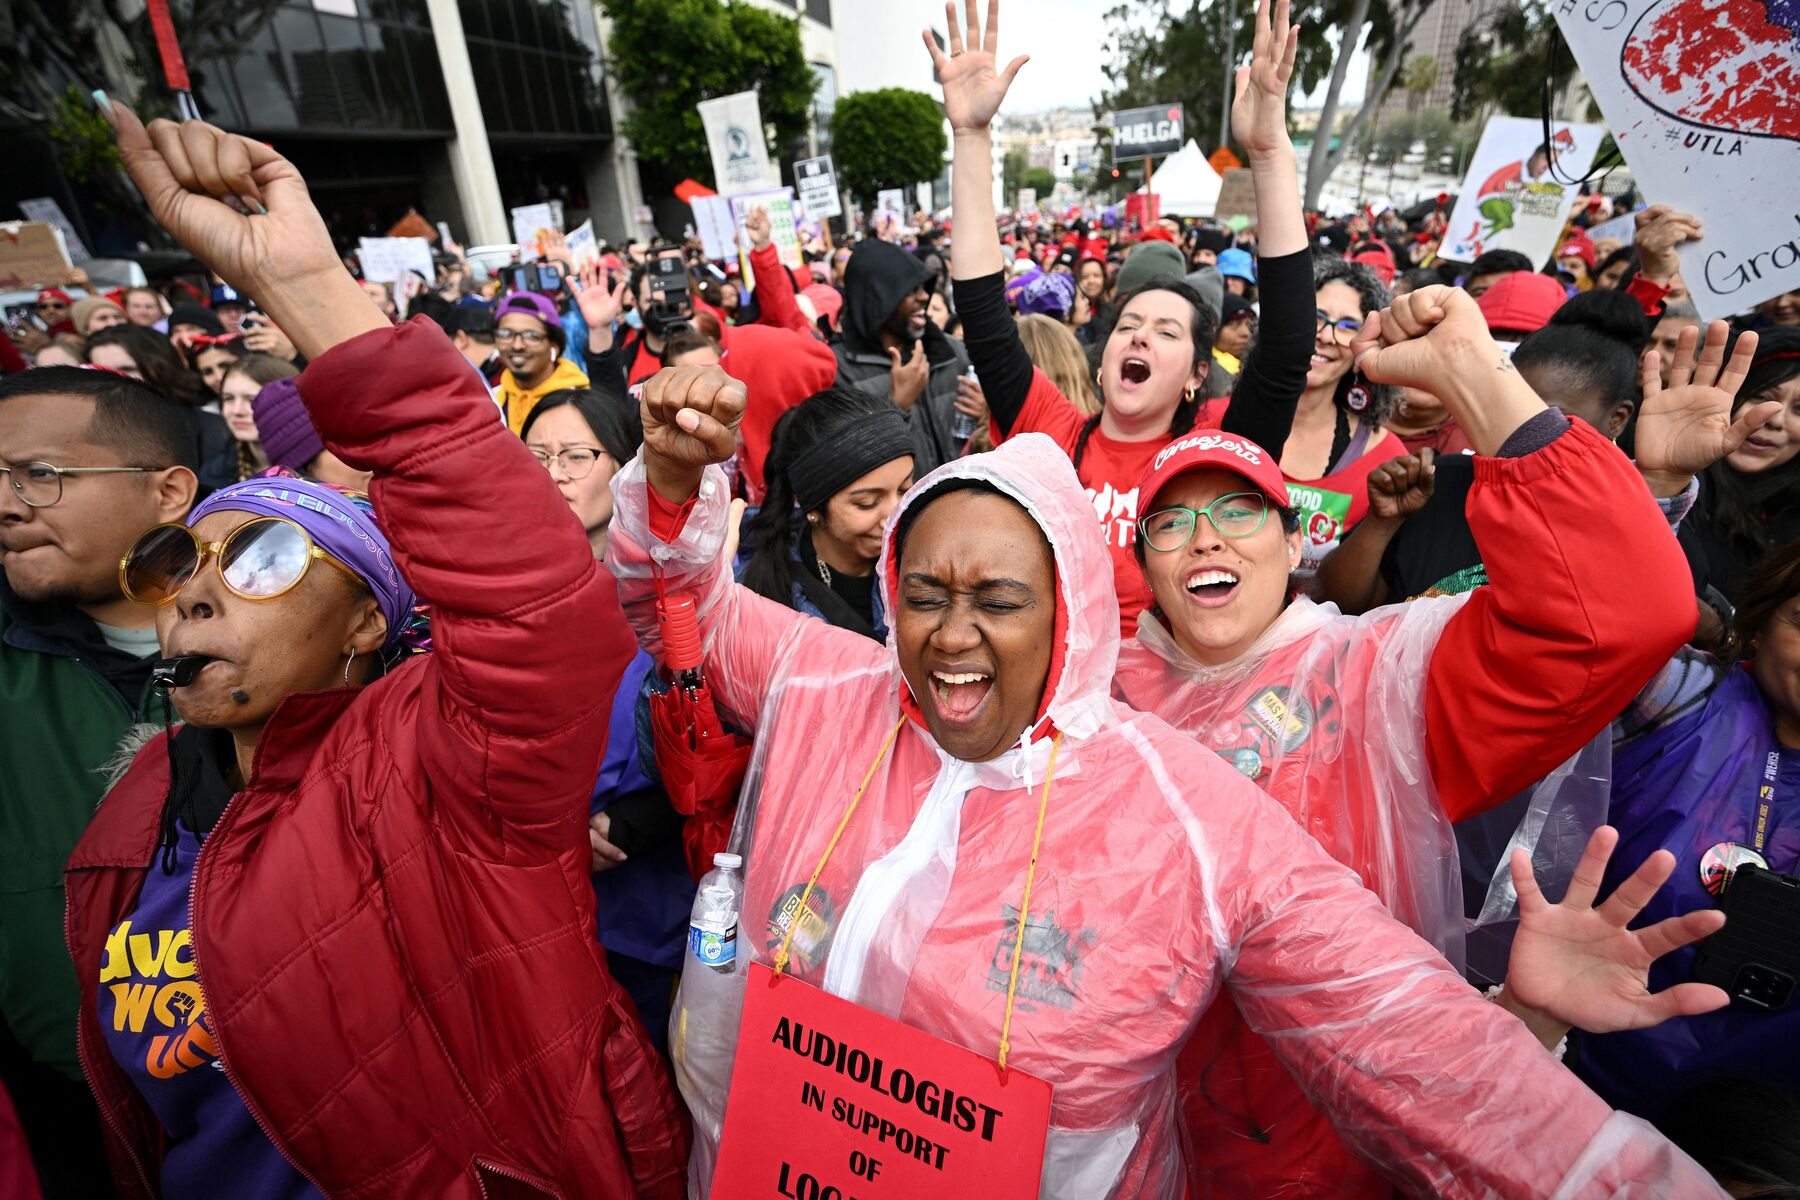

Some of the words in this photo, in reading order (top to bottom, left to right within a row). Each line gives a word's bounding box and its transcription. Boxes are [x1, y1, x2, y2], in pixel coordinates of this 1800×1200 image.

[1113, 118, 1181, 146] HUELGA
[1664, 126, 1743, 156] #UTLA
[1705, 214, 1800, 295] Gra
[772, 1016, 1003, 1142] AUDIOLOGIST
[801, 1081, 825, 1112] IN
[832, 1096, 950, 1170] SUPPORT
[849, 1150, 882, 1182] OF
